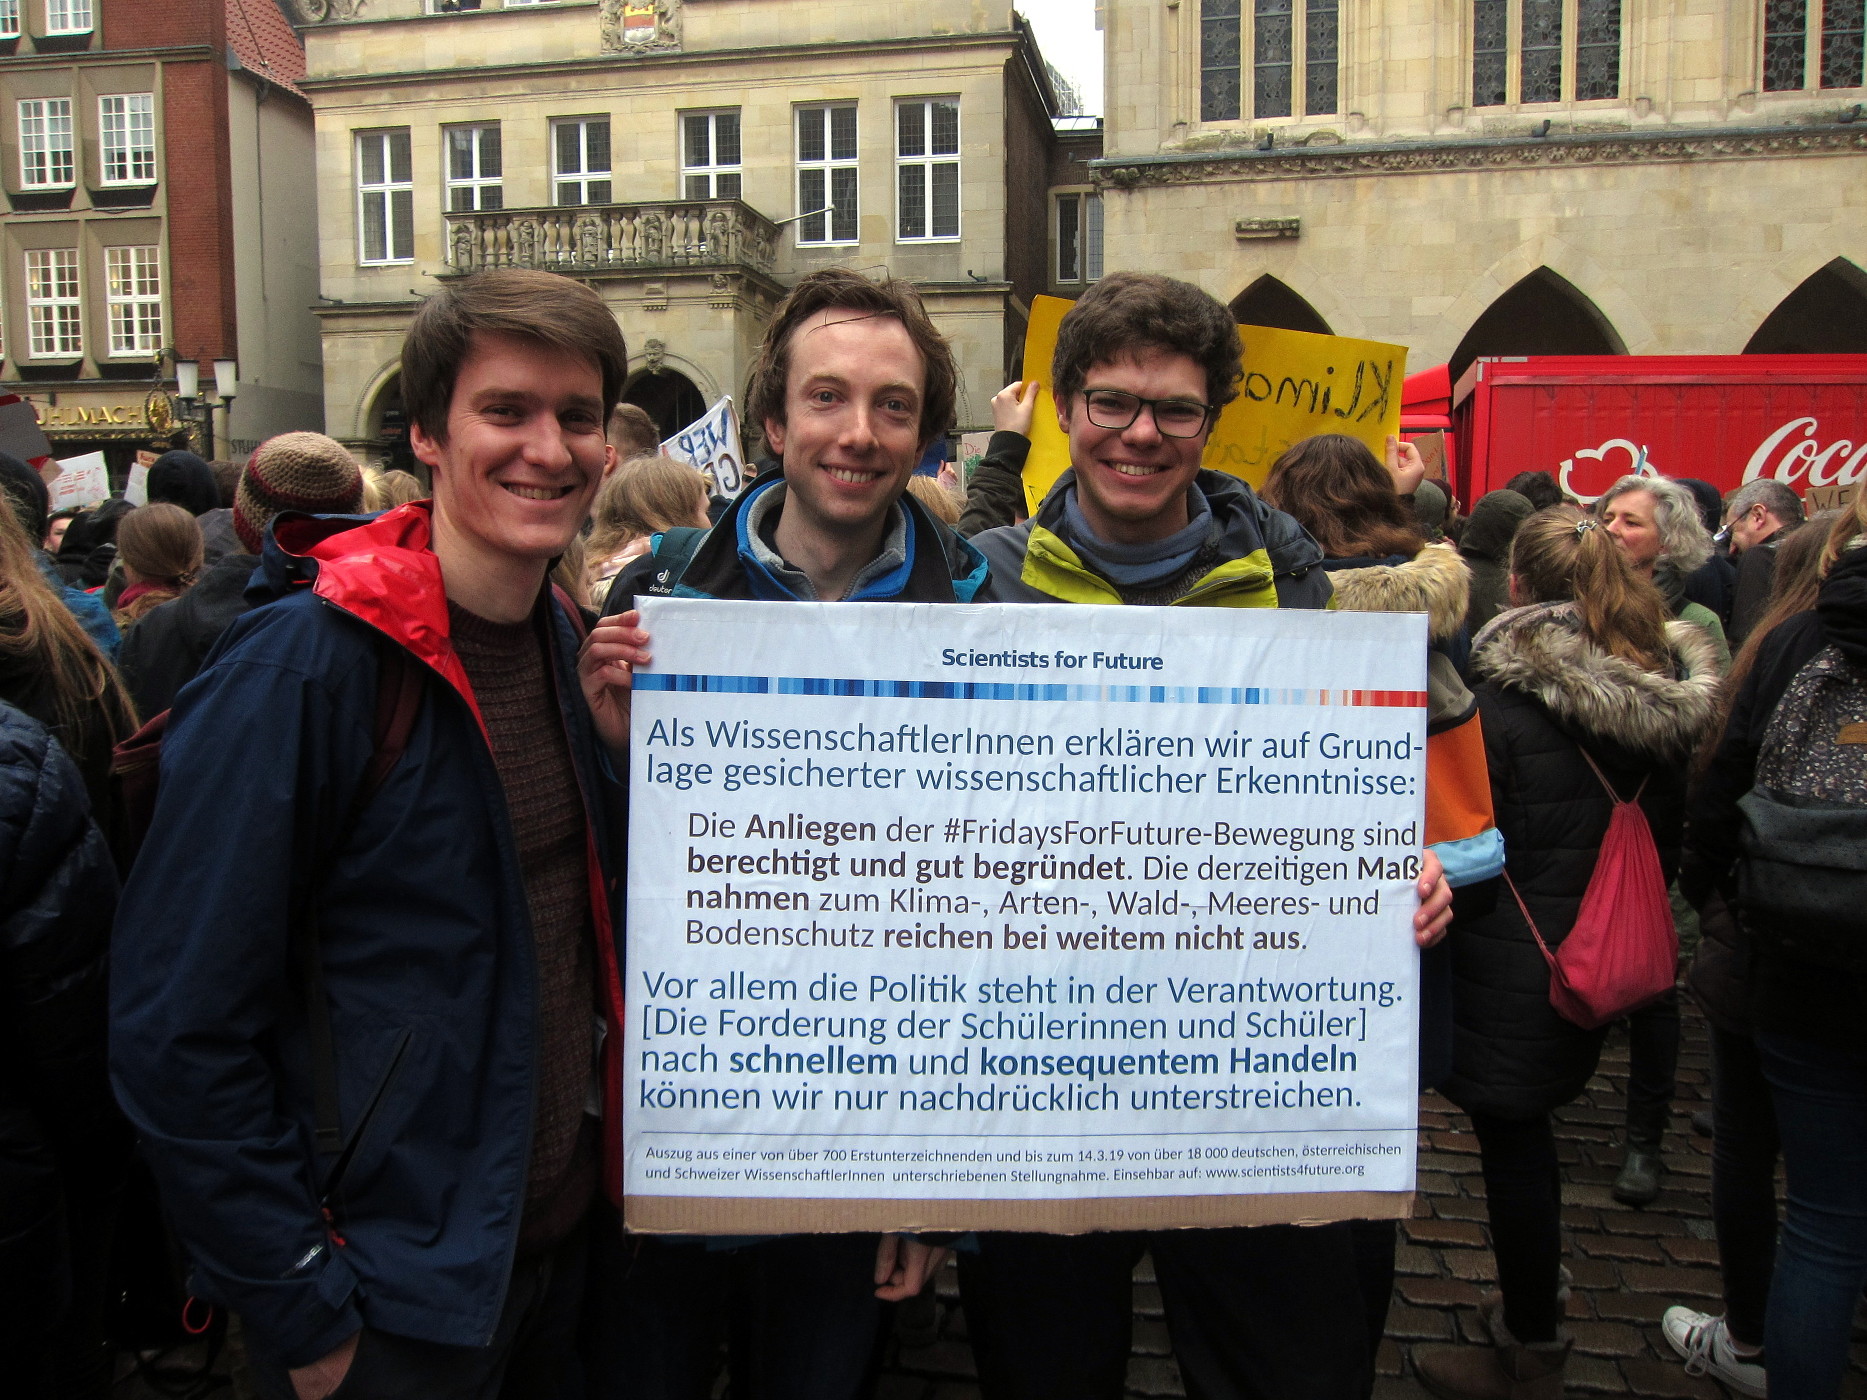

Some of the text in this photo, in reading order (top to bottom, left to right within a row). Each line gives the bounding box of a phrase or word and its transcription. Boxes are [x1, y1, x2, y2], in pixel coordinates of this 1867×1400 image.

[231, 439, 262, 454] STUH
[649, 584, 673, 594] deuter
[942, 649, 1163, 670] Scientists for Future
[646, 718, 1422, 760] Als WissenschaftlerInnen erklären wir auf Grund-
[648, 754, 1415, 795] lage gesicherter wissenschaftlicher Erkenntnisse:
[689, 812, 1416, 851] Die Anliegen der #FridaysForFuture-Bewegung sind
[688, 846, 1423, 886] berechtigt und gut begründet. Die derzeitigen Maß
[687, 883, 1378, 919] nahmen zum Klima-, Arten-, Wald-, Meeres- und
[687, 919, 1306, 950] Bodenschutz reichen bei weitem nicht aus.
[643, 971, 1402, 1007] Vor allem die Politik steht in der Verantwortung.
[643, 1005, 1366, 1045] [Die Forderung der Schülerinnen und Schüler]
[642, 1043, 1356, 1082] nach schnellem und konsequentem Handeln
[641, 1079, 1360, 1111] können wir nur nachdrücklich unterstreichen.
[645, 1143, 1401, 1163] Auszug aus einer von über 700 Erstunterzeichnenden und bis zum 14.3.19 von über 18 000 deutschen, österreichischen
[645, 1163, 1365, 1184] und Schweizer WissenschaftlerInnen unterschriebenen Stellungnahme. Einsehbar auf: www.scientists4future.org
